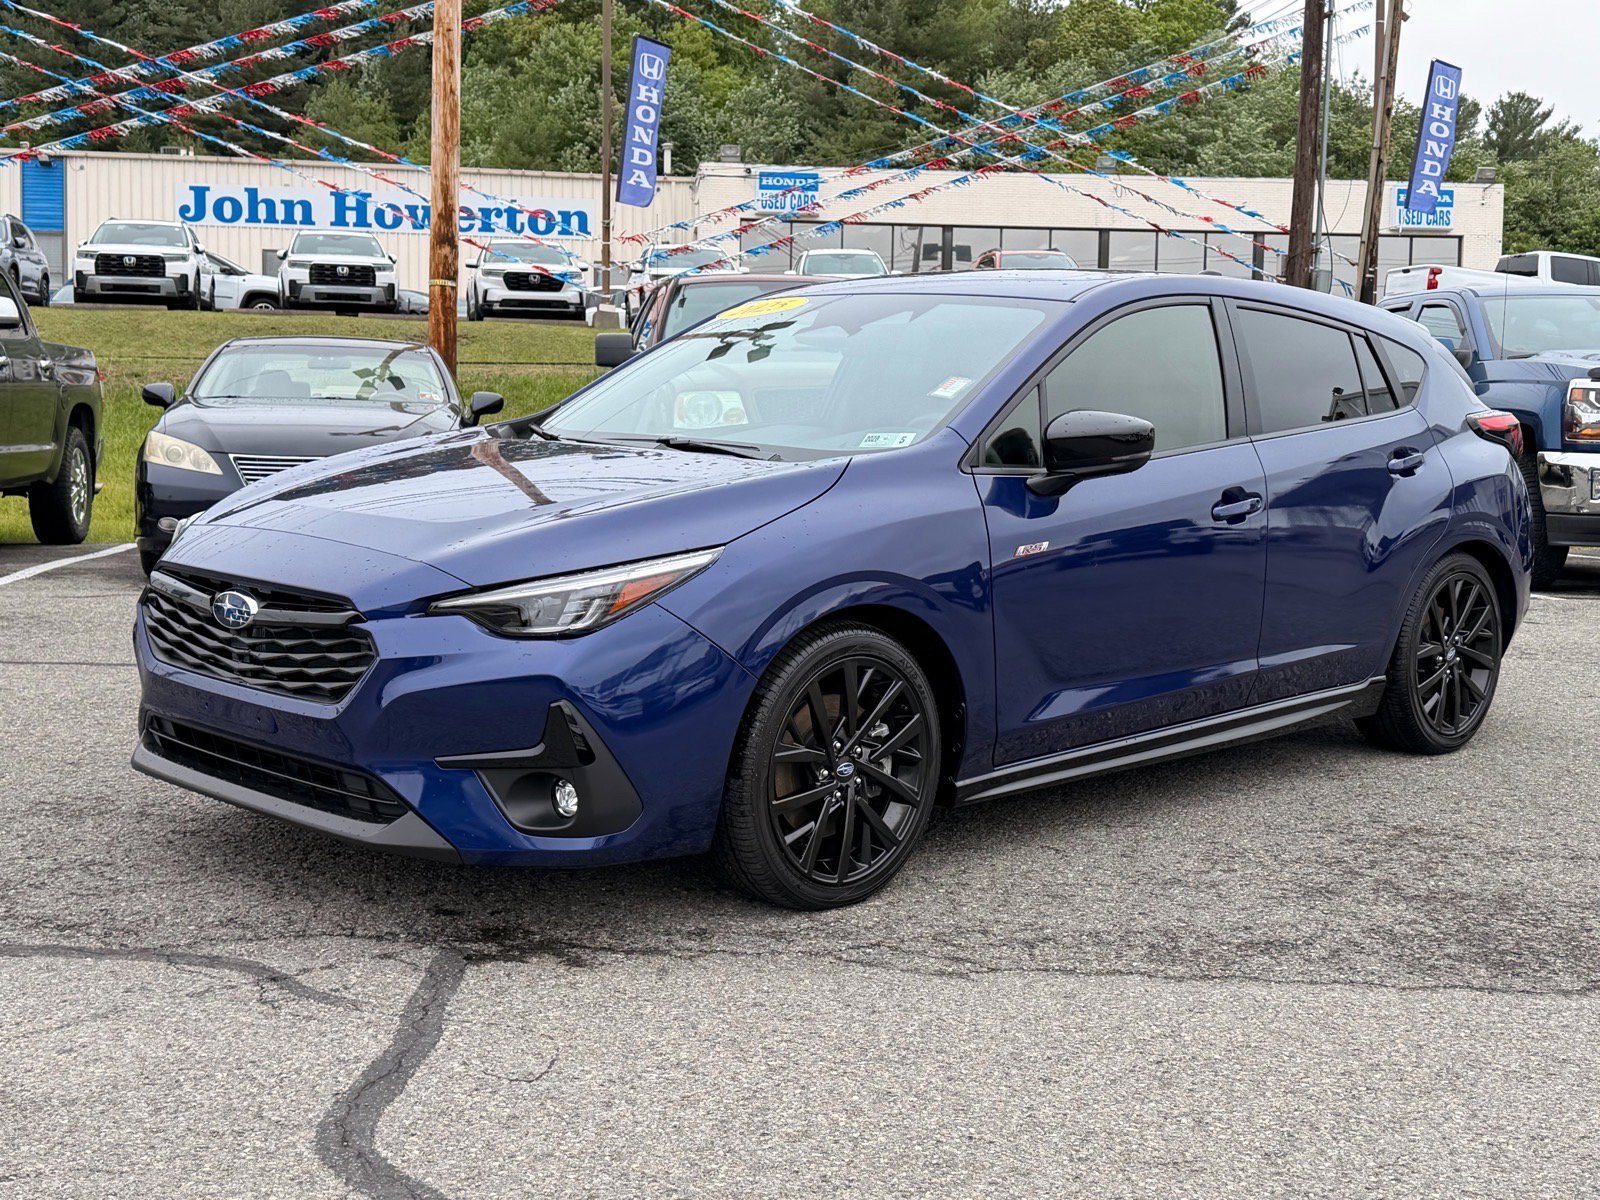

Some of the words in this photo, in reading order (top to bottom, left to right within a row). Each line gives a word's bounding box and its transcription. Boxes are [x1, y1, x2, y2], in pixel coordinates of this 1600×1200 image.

[627, 84, 660, 189] HONDA
[1416, 102, 1454, 198] HONDA
[178, 185, 315, 225] John
[1426, 210, 1451, 226] CARS
